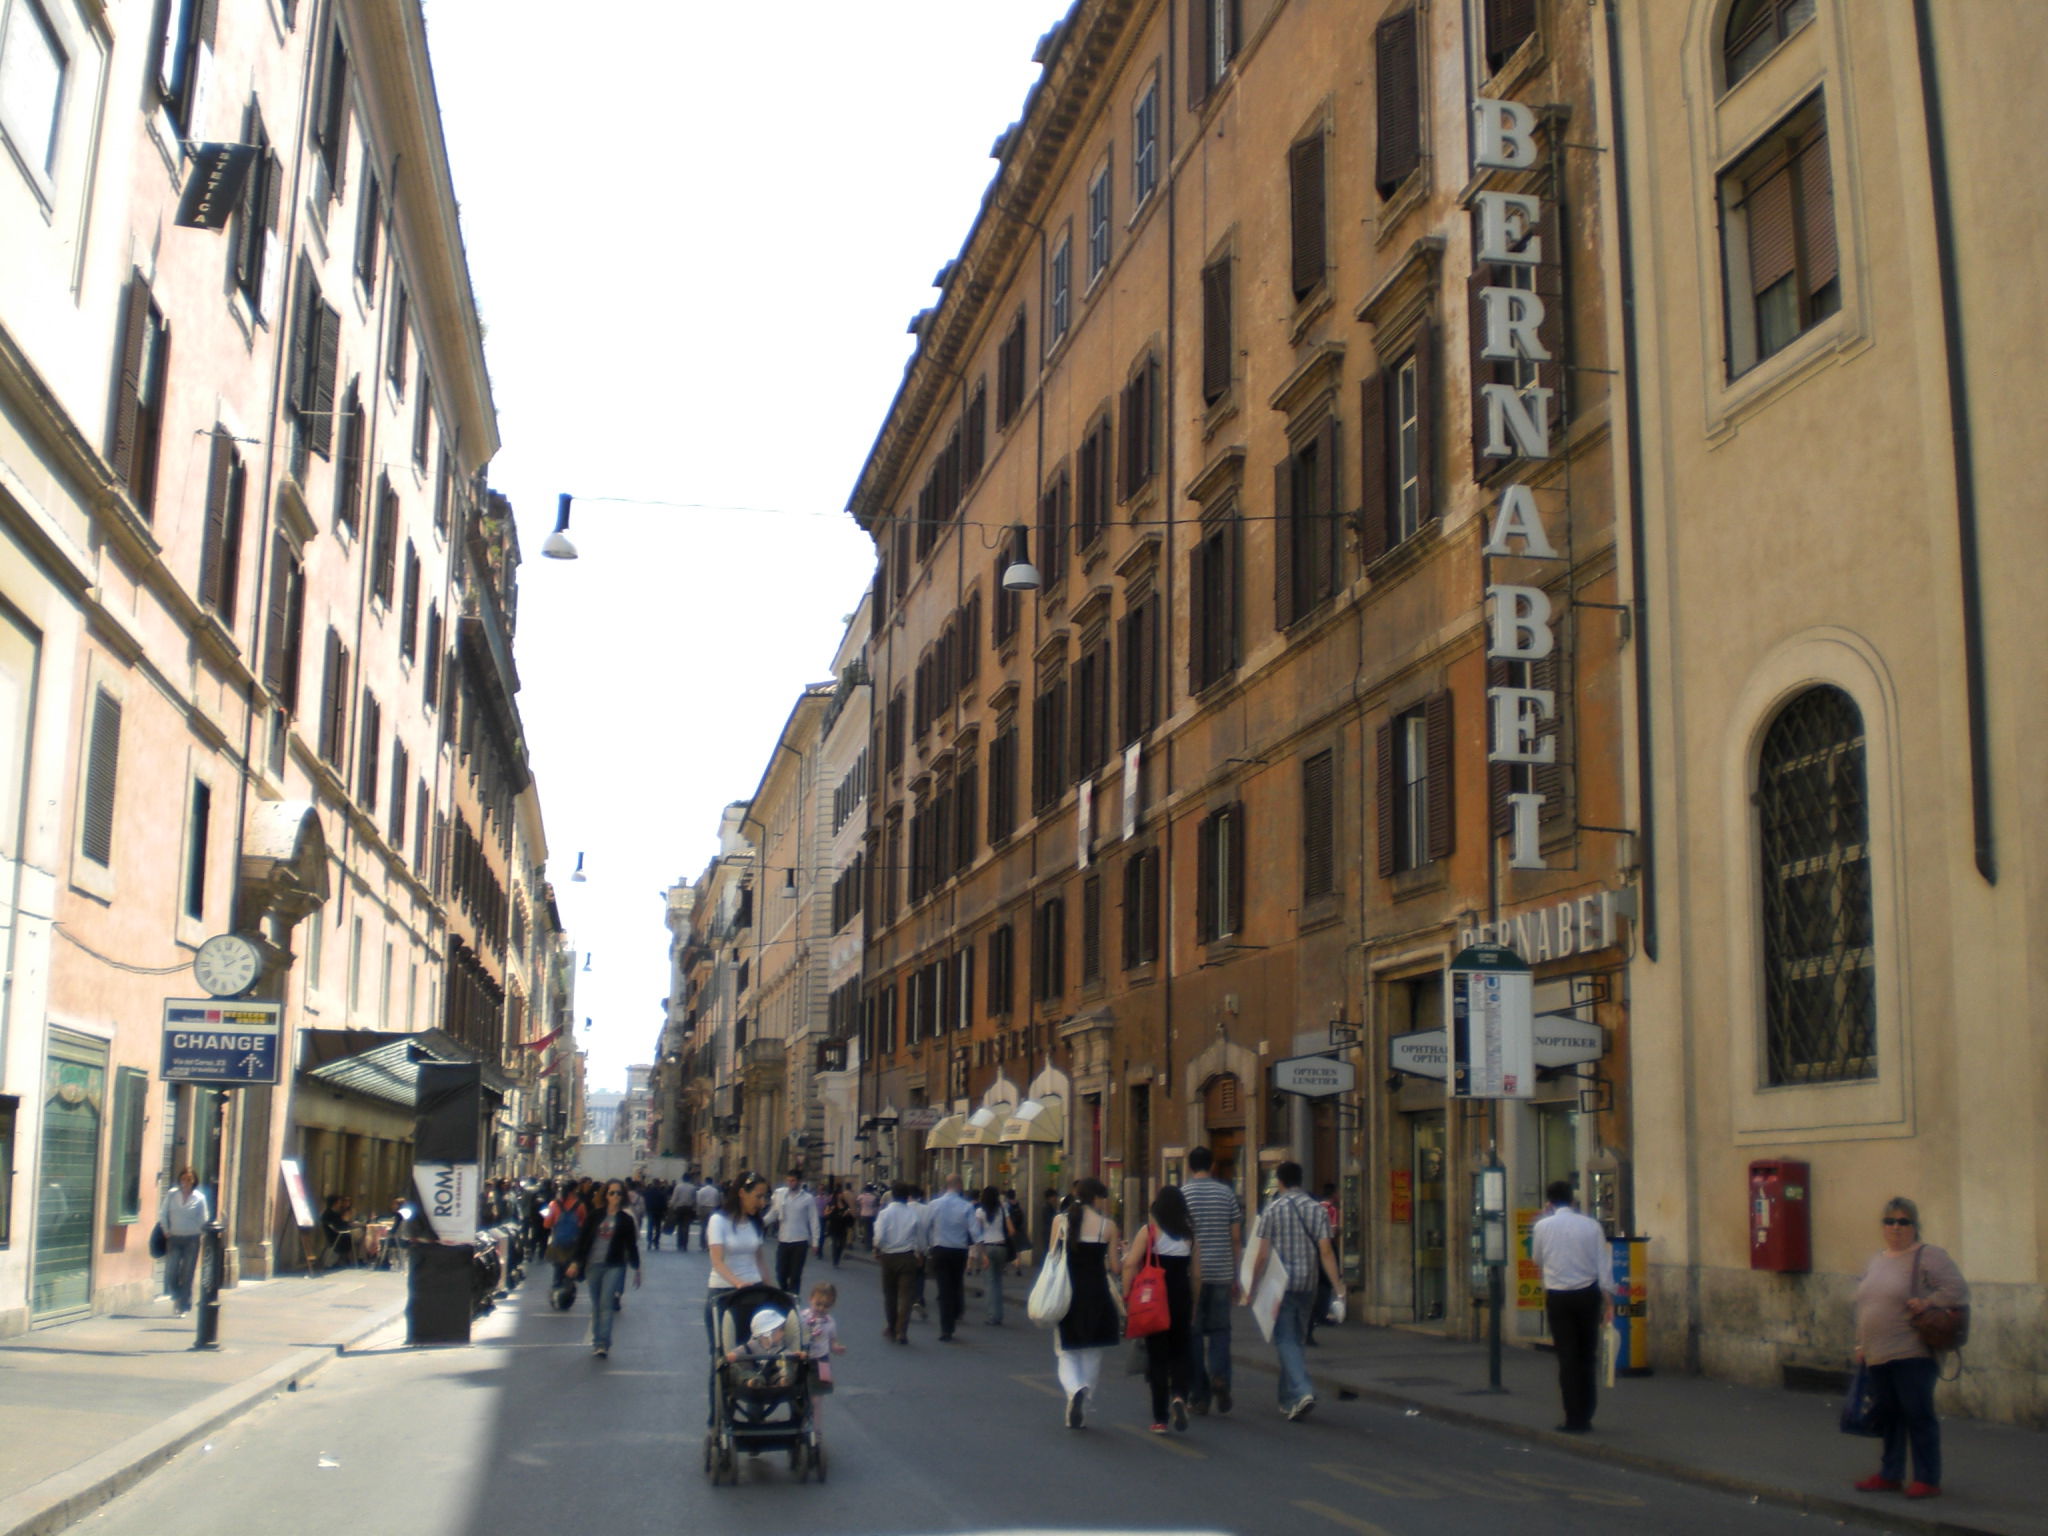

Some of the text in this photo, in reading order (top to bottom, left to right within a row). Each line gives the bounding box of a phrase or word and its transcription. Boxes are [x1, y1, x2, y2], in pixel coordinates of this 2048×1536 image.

[193, 143, 234, 223] ESTETICA
[1473, 100, 1559, 870] BERNABEI
[173, 1033, 265, 1052] CHANGE
[1533, 1036, 1597, 1048] NOPTIKER
[433, 1166, 454, 1217] ROM
